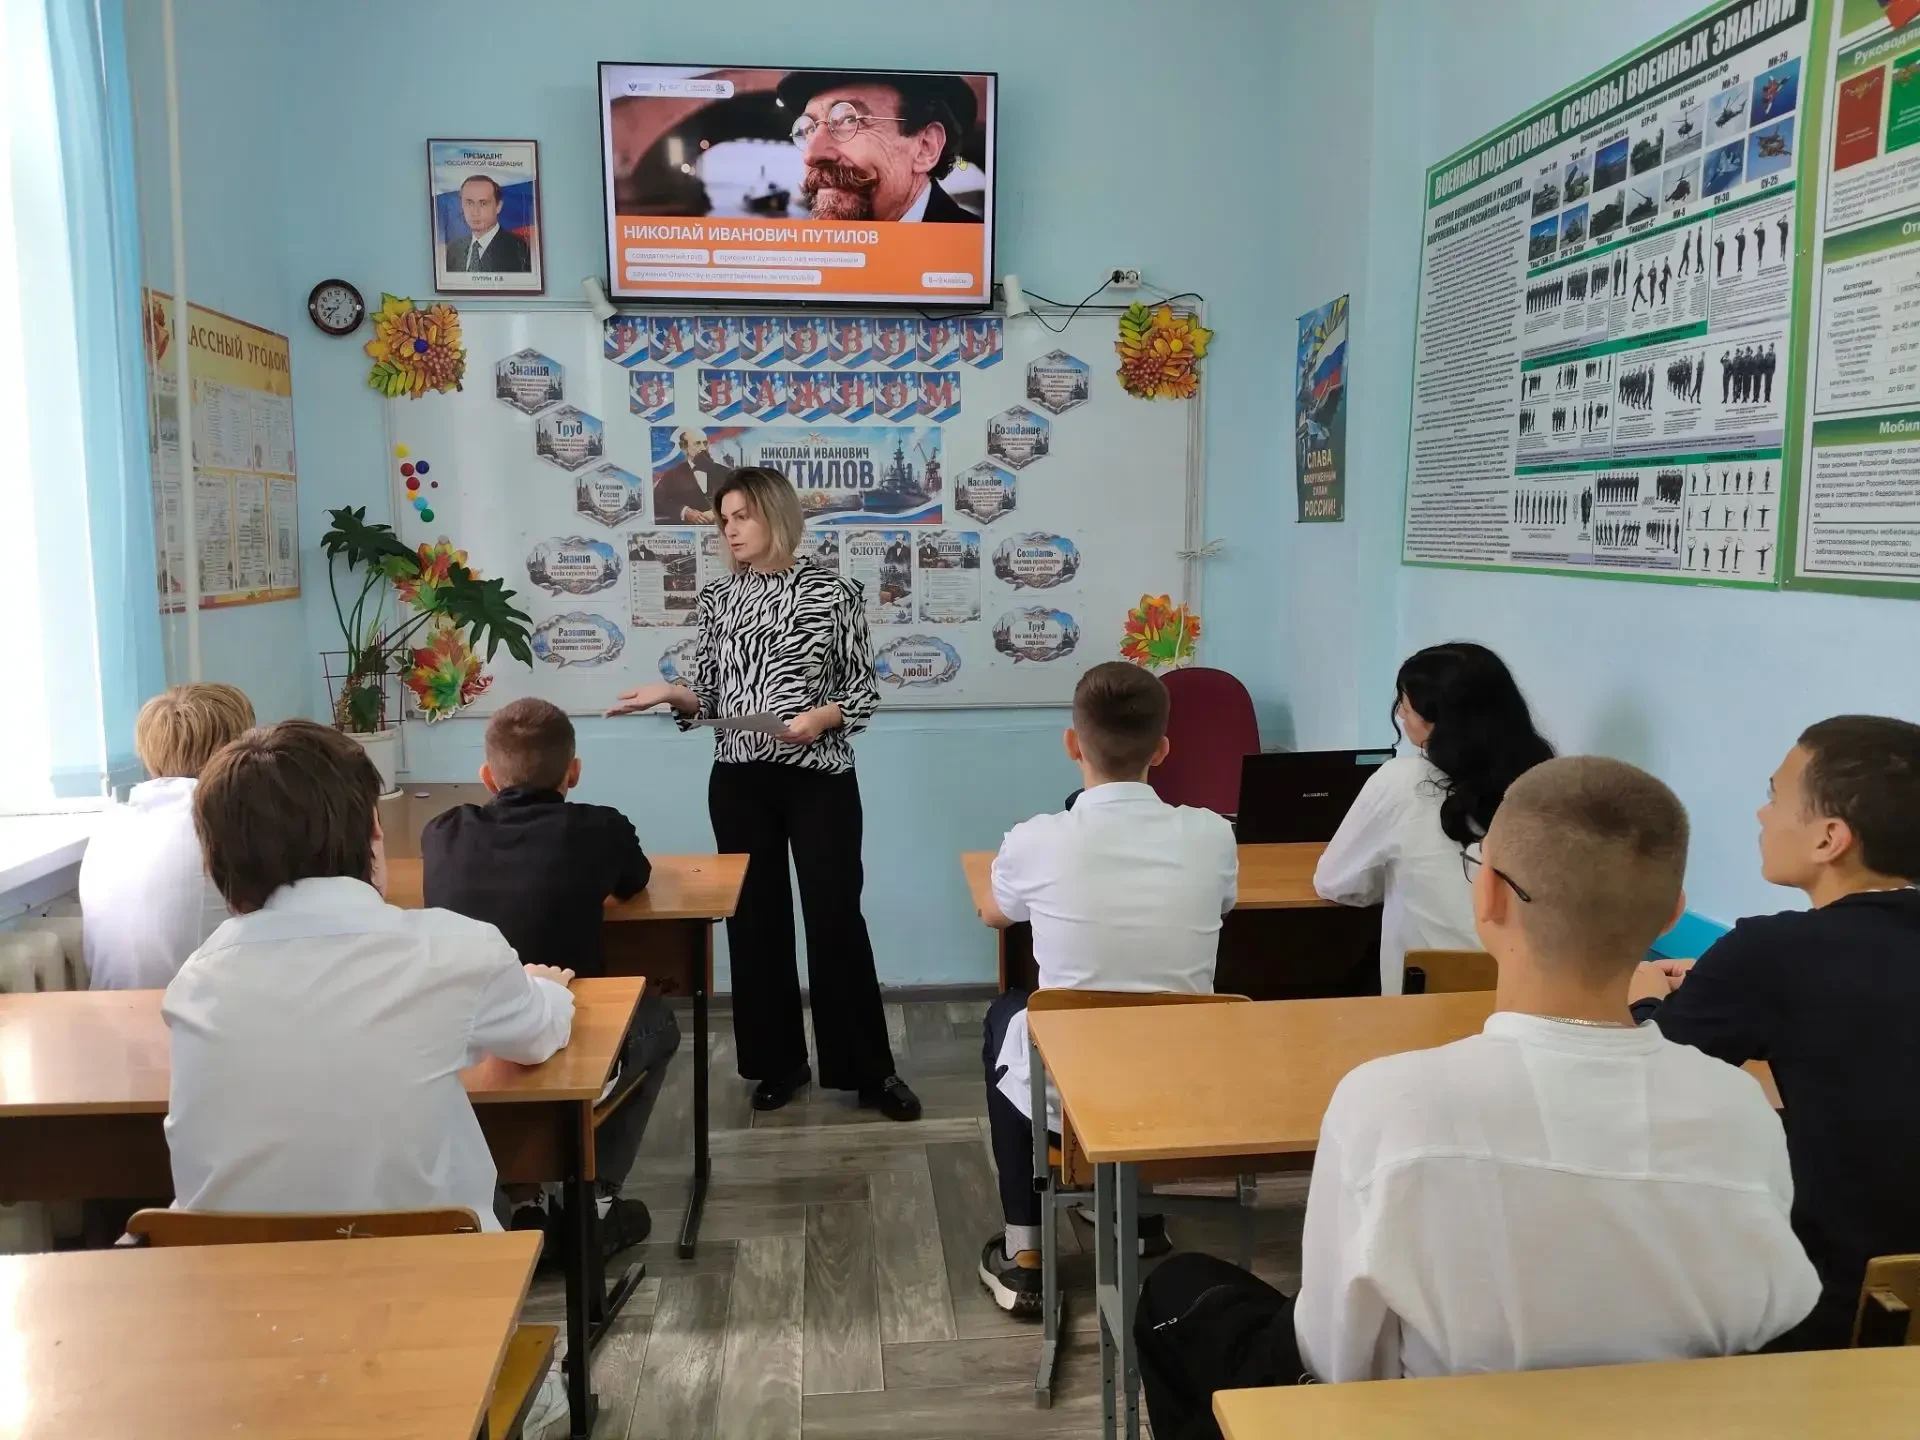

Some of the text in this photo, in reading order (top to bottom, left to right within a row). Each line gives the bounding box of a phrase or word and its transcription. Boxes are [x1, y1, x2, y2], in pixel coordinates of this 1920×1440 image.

[1434, 154, 1480, 199] ВОЕННАЯ
[1480, 111, 1559, 176] ПОДГОТОВКА.
[1561, 74, 1625, 134] ОСНОВЫ
[1626, 27, 1710, 101] ВОЕННЫХ
[444, 159, 524, 168] РОССИЙСКОЙ ФЕДЕРАЦИИ
[463, 152, 503, 160] ПРЕЗИДЕНТ
[1497, 176, 1523, 197] РАЗВИТИЯ
[1469, 202, 1500, 227] РОССИЙСКОЙ
[1500, 187, 1532, 213] ФЕДЕРАЦИИ
[623, 224, 880, 245] НИКОЛАЙ ИВАНОВИЧ ПУТИЛОВ
[1842, 279, 1873, 292] Категории
[172, 319, 289, 373] АССНЫЙ УГОЛОК
[616, 325, 998, 357] РАЗГОВОРЫ
[509, 361, 550, 377] Знания
[710, 379, 953, 410] ВАЖНОМ
[556, 420, 583, 438] Труд
[994, 423, 1041, 436] Созидание
[760, 444, 870, 460] НИКОЛАЙ ИВАНОВИЧ
[1307, 448, 1333, 469] СЛАВА
[759, 459, 875, 489] УТИЛОВ
[967, 476, 1002, 487] Наследие
[1304, 497, 1337, 518] РОССИИ!
[557, 552, 591, 564] Знания
[850, 546, 887, 556] ФЛОТА
[558, 627, 597, 637] Развитие
[1028, 620, 1046, 633] Труд
[902, 663, 933, 677] люди!
